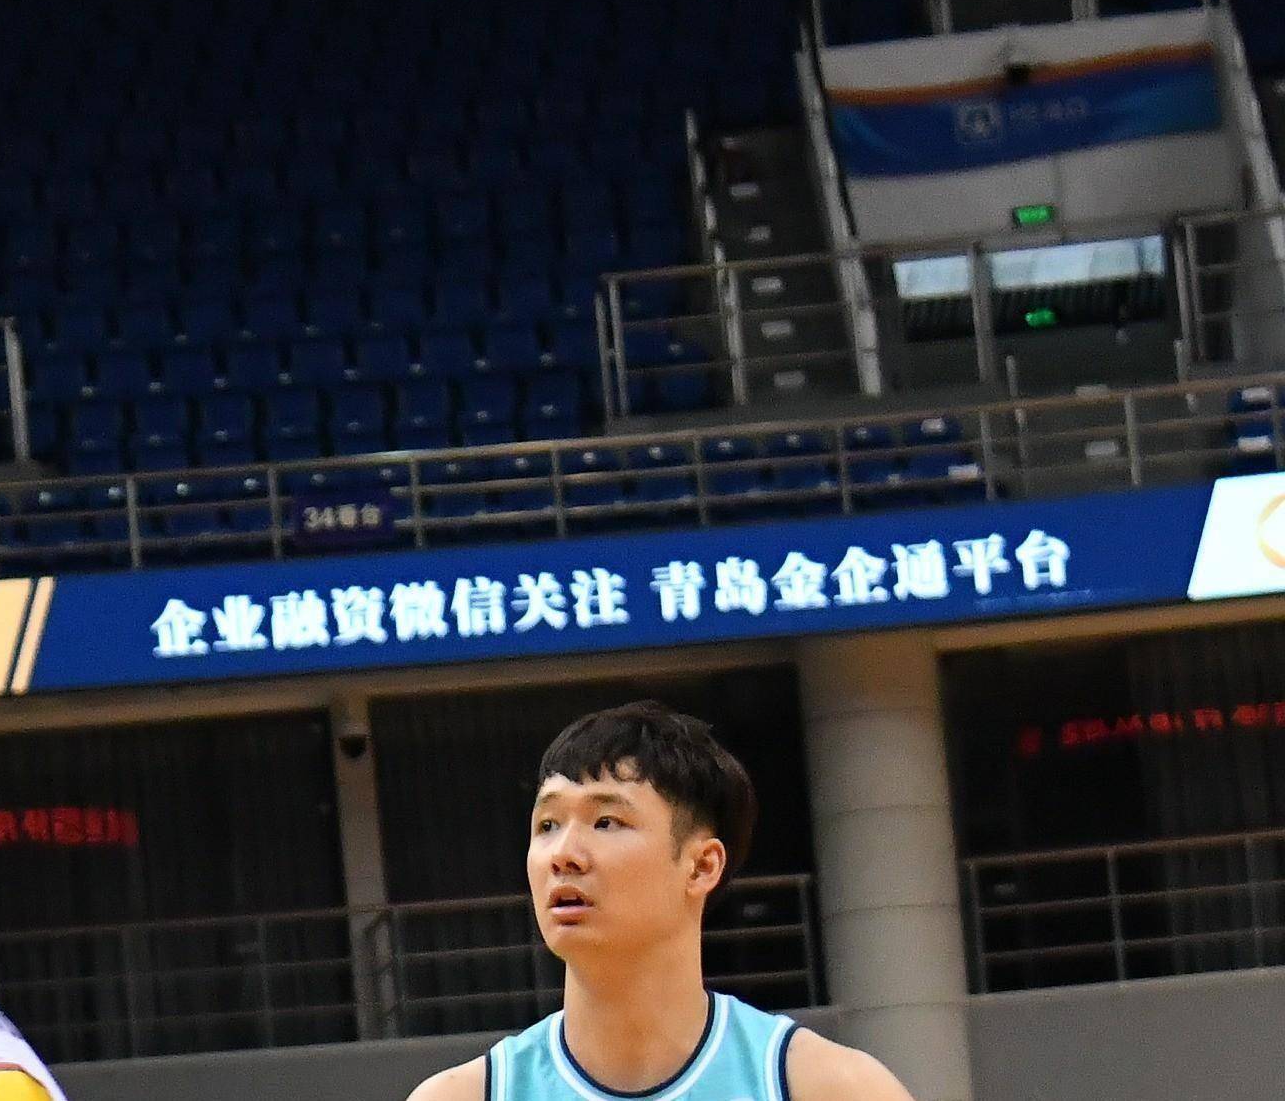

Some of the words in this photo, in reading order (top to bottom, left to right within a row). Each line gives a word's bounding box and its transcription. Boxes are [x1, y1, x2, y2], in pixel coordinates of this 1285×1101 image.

[151, 567, 630, 658] 企业融资微信关注
[649, 528, 1072, 622] 青岛金企通平台
